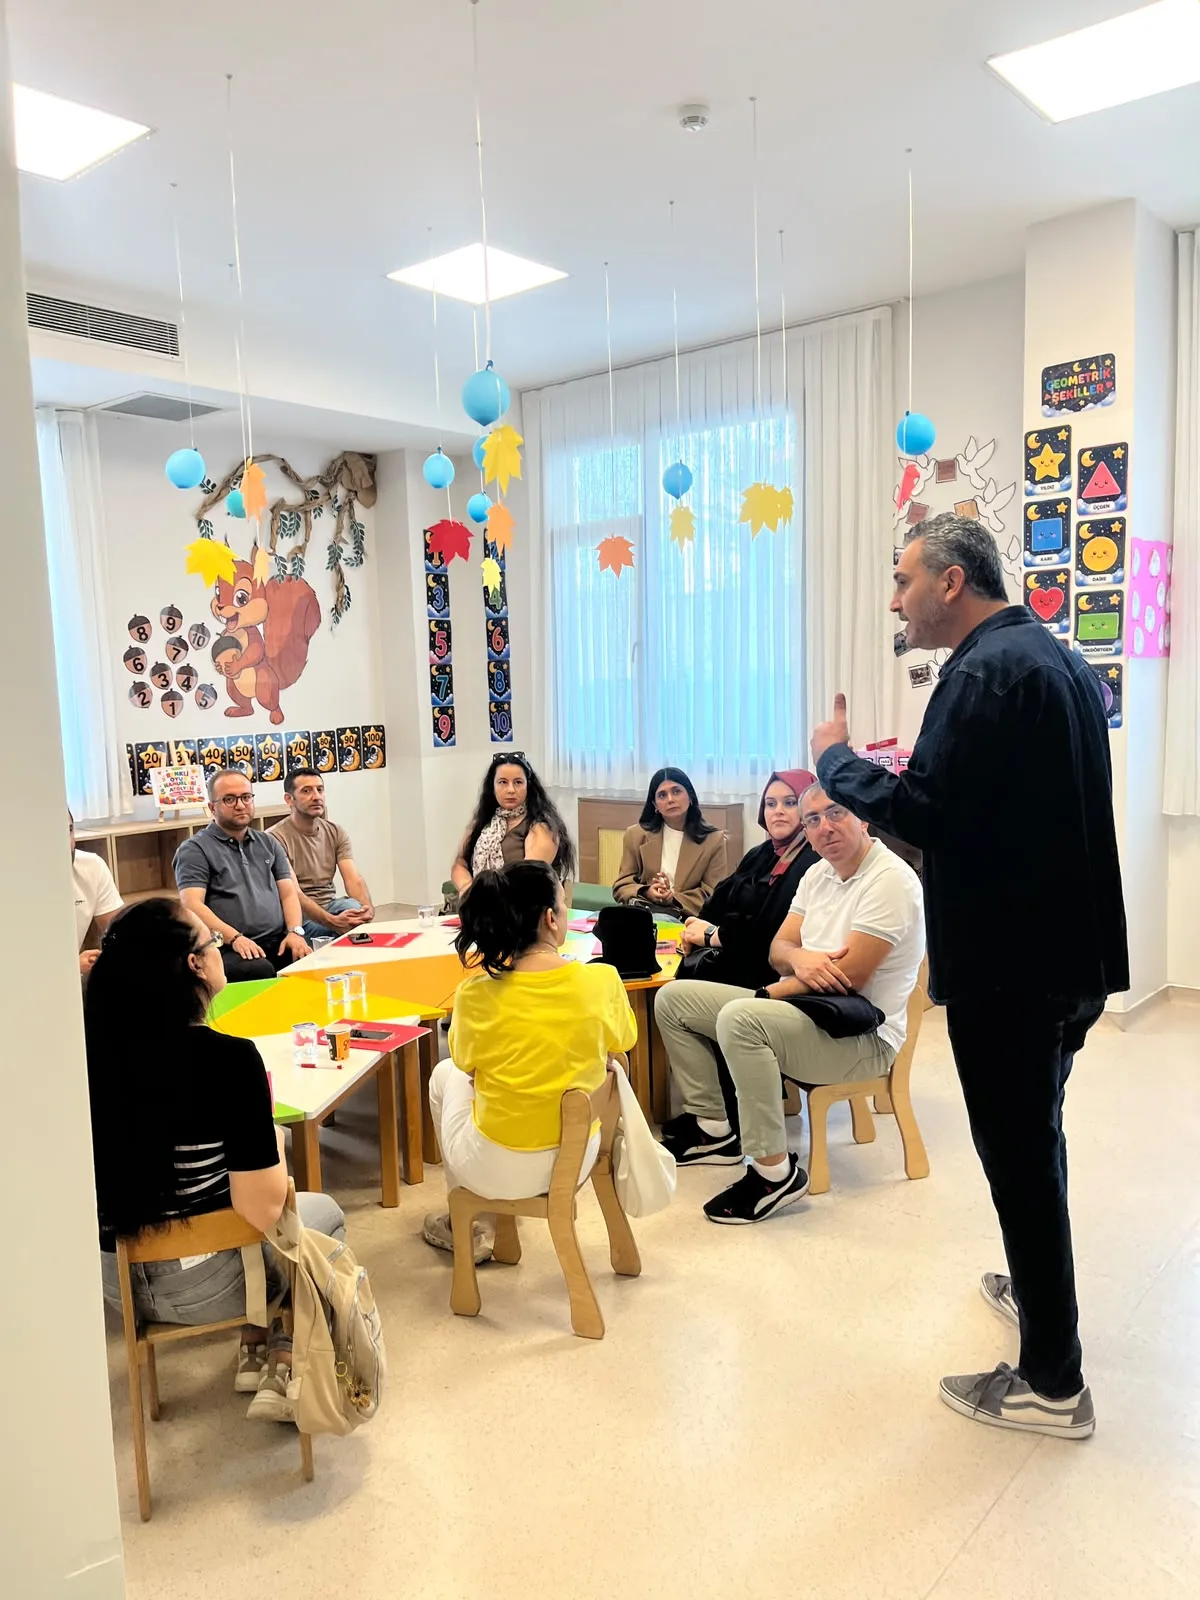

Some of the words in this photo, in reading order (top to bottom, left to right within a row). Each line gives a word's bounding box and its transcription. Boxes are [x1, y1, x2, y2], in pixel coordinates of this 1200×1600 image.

[1046, 368, 1112, 391] GEOMETRİK
[1052, 383, 1104, 405] ŞEKİLLER
[1092, 503, 1110, 511] ÜÇGEN
[432, 586, 445, 610] 3
[489, 587, 503, 610] 4
[166, 616, 176, 631] 9
[136, 626, 149, 641] 8
[192, 632, 206, 648] 10
[491, 627, 504, 651] 6
[434, 630, 448, 657] 5
[172, 646, 181, 661] 7
[132, 657, 144, 672] 6
[158, 673, 169, 687] 3
[181, 676, 192, 691] 4
[436, 674, 449, 700] 7
[493, 670, 505, 692] 8
[138, 691, 150, 706] 2
[199, 693, 211, 708] 5
[169, 702, 175, 715] 1
[438, 714, 451, 739] 9
[492, 711, 510, 733] 10
[144, 752, 159, 764] 20
[205, 748, 220, 759] 40
[235, 745, 249, 757] 50
[263, 742, 277, 755] 60
[294, 741, 306, 752] 70
[319, 737, 329, 745] 80
[344, 735, 354, 744] 90
[367, 733, 380, 742] 100
